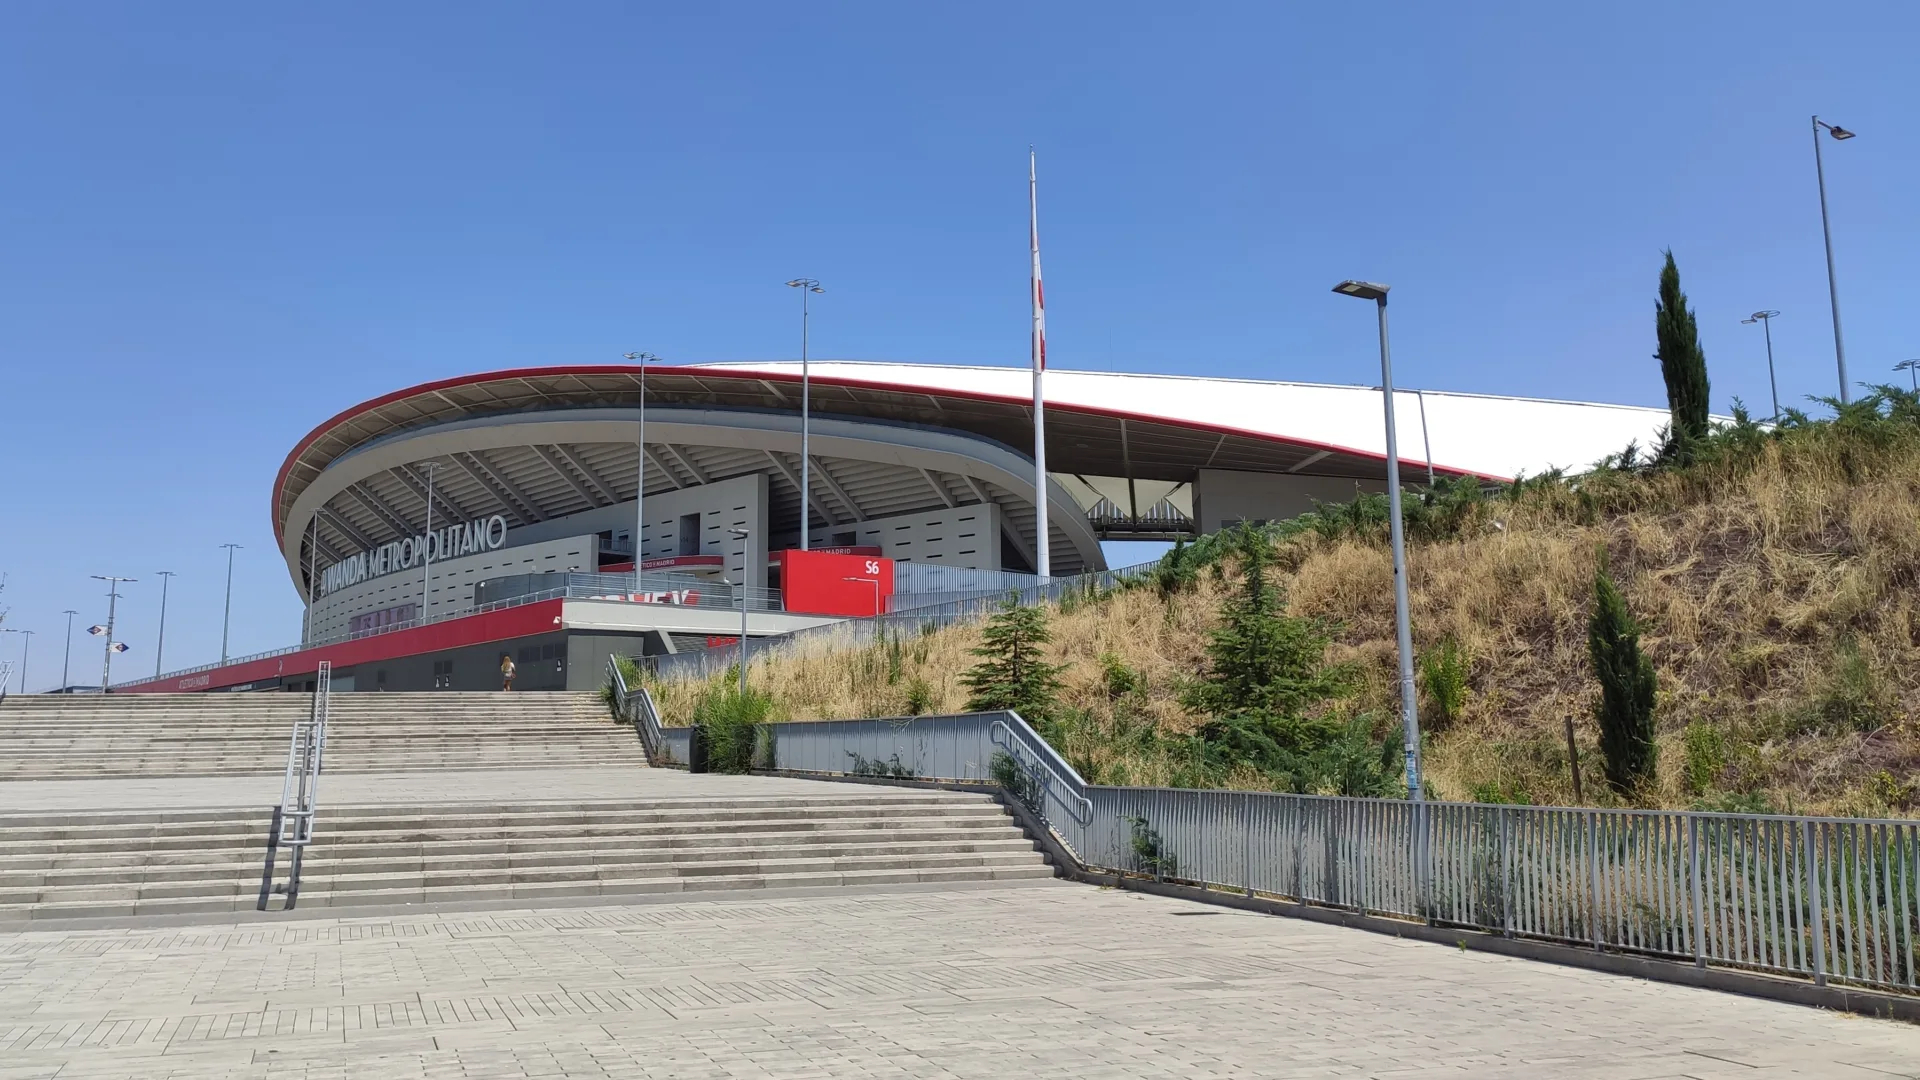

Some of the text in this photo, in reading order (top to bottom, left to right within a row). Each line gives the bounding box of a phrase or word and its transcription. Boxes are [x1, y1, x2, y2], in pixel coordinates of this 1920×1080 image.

[326, 514, 507, 593] WANDA METROPOLITANO
[656, 559, 675, 567] MADRID
[865, 560, 879, 574] S6
